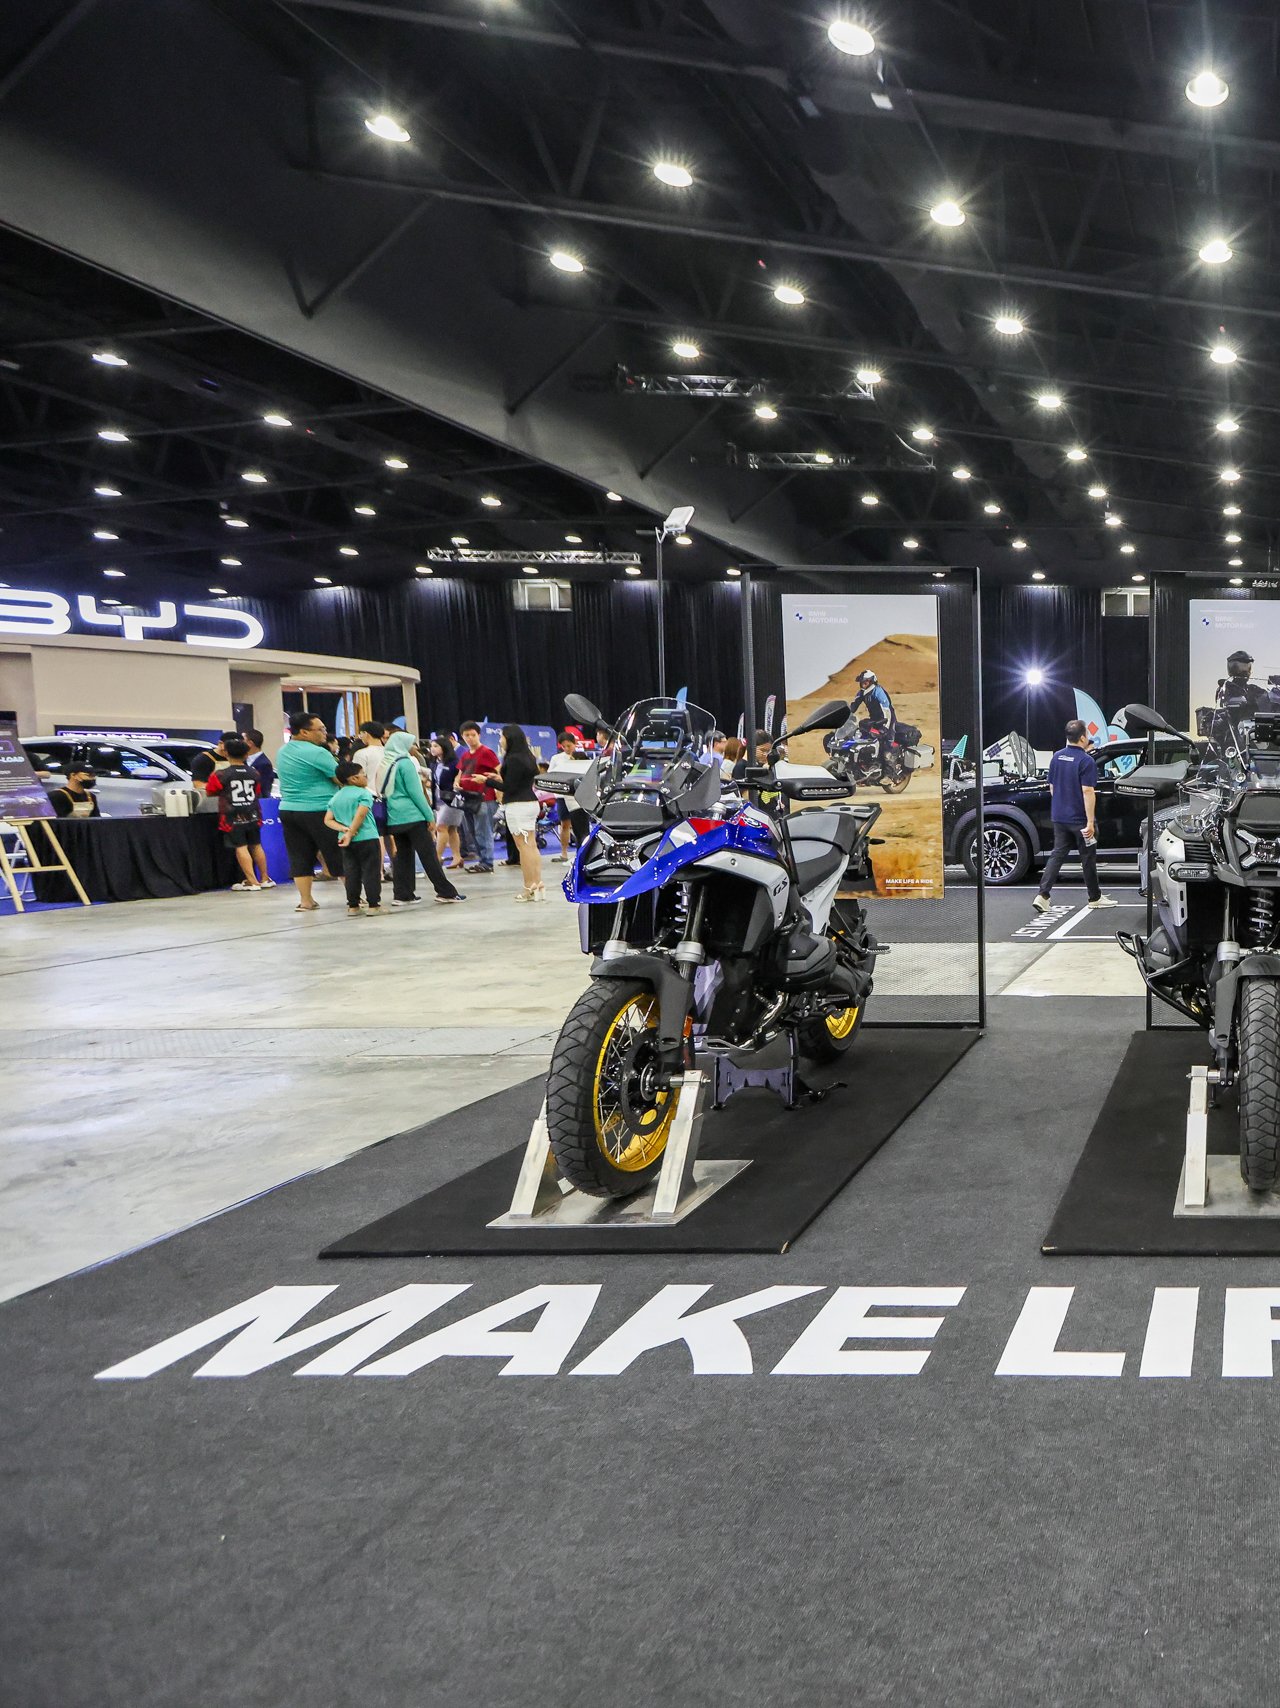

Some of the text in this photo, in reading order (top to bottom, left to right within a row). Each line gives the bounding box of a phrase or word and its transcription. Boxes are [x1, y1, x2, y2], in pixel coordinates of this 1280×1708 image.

[0, 588, 264, 649] BYD
[230, 779, 256, 802] 25
[773, 877, 788, 896] GS
[94, 1283, 968, 1379] MAKE
